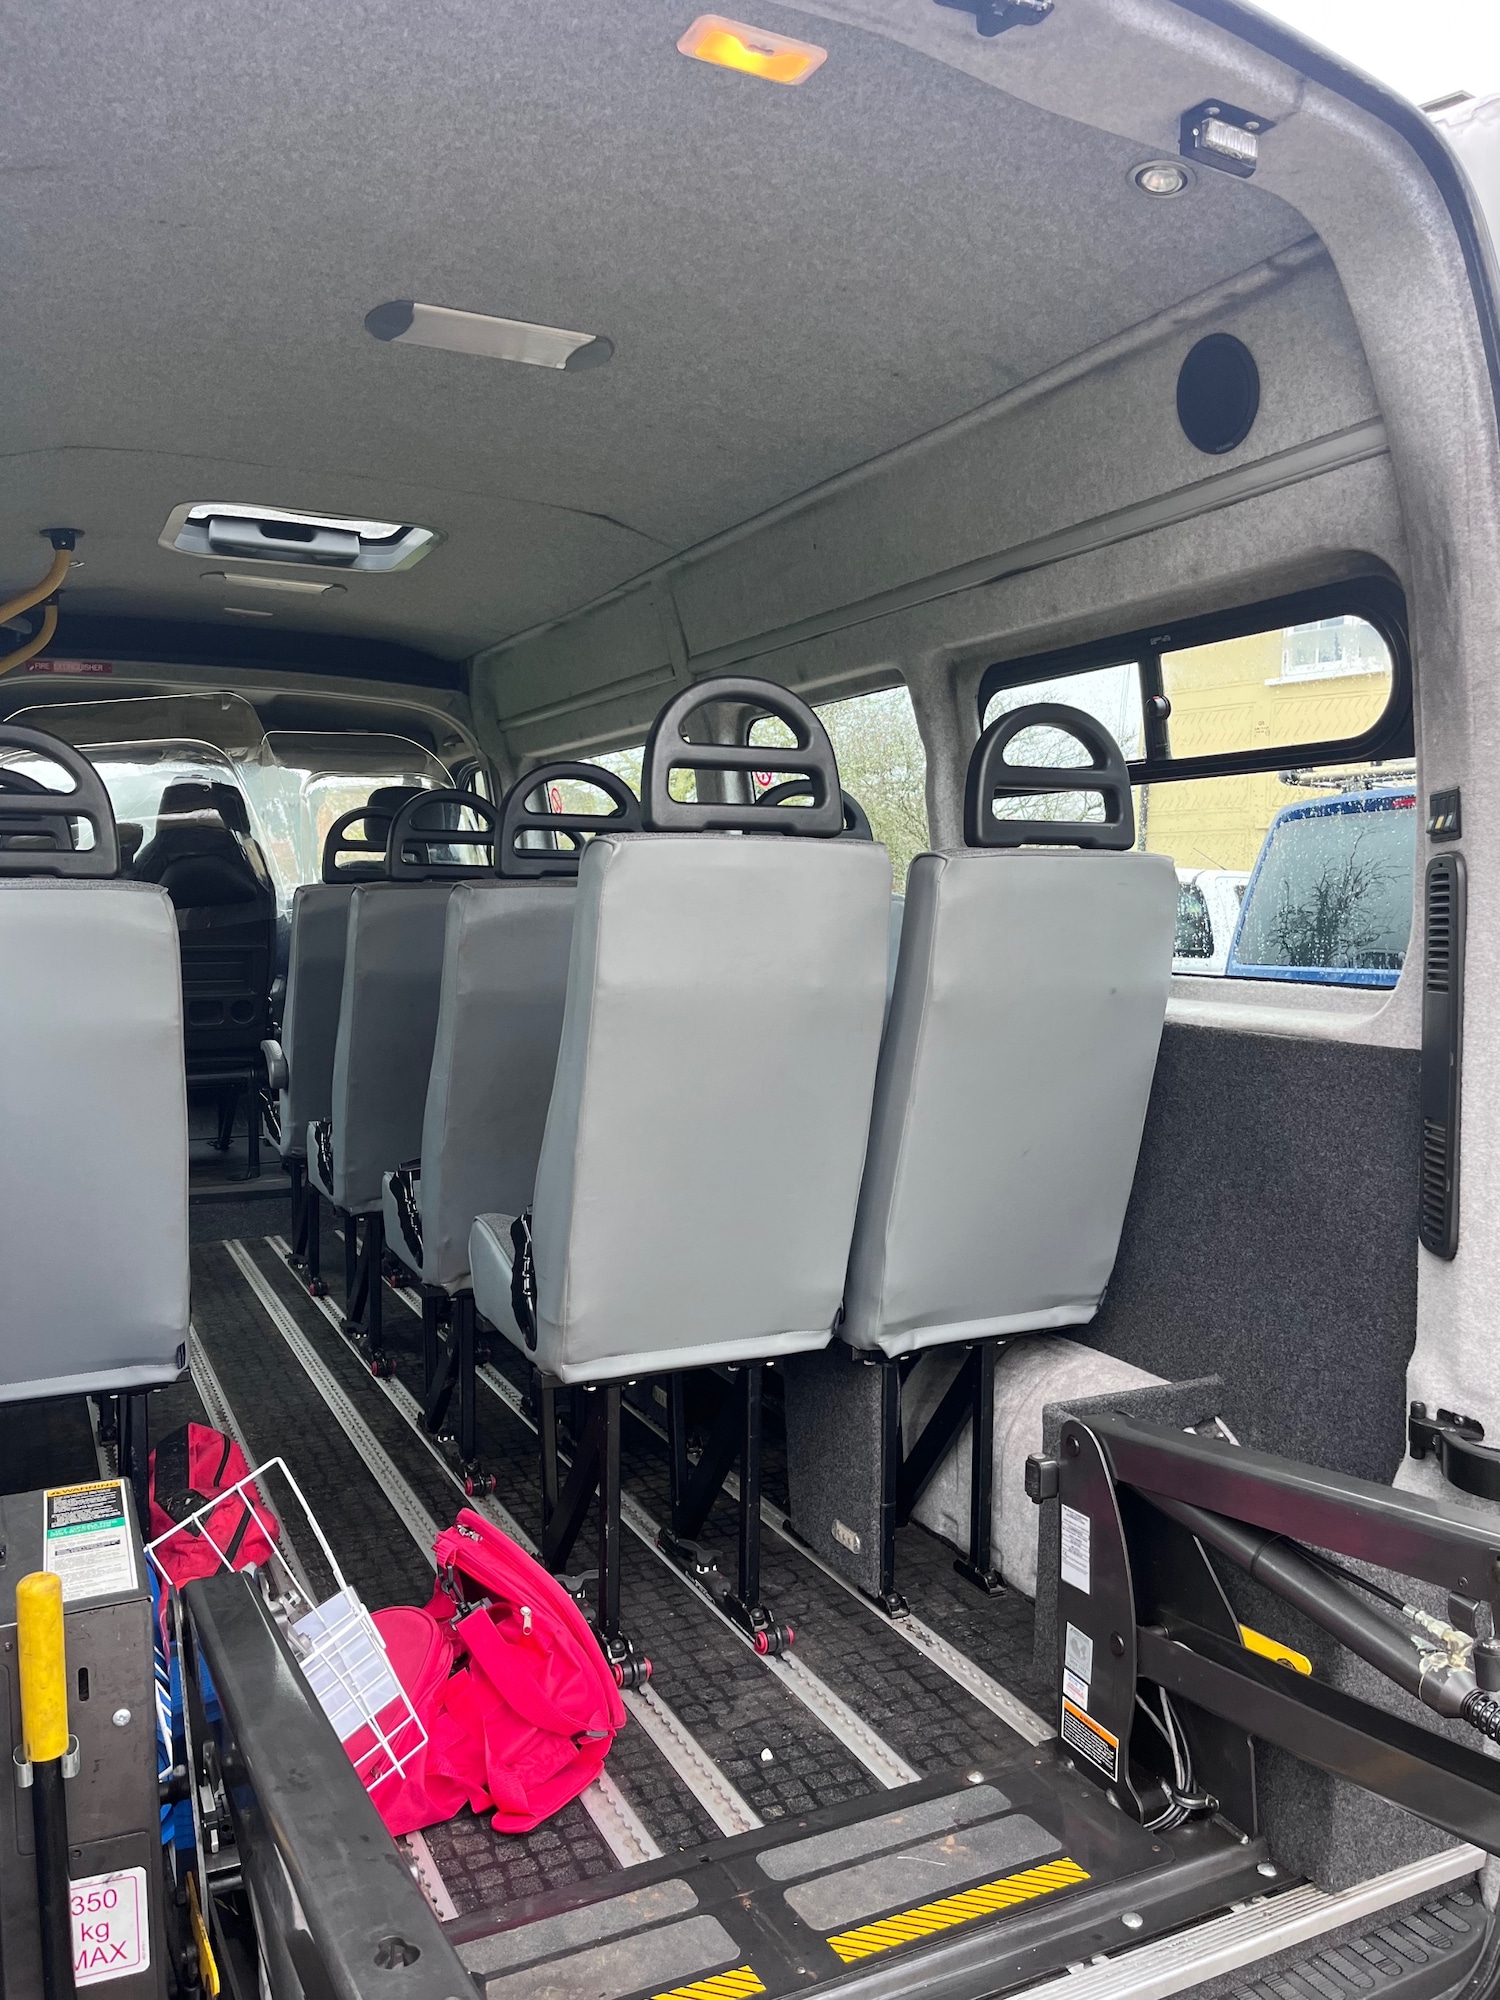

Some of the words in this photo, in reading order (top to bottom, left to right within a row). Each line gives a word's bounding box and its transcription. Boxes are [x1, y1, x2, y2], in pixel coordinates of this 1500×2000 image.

[34, 662, 50, 670] FIRE
[53, 663, 103, 672] EXTINGUISHER
[62, 1481, 119, 1492] WARNING
[70, 1888, 118, 1916] 350
[81, 1922, 109, 1943] kg
